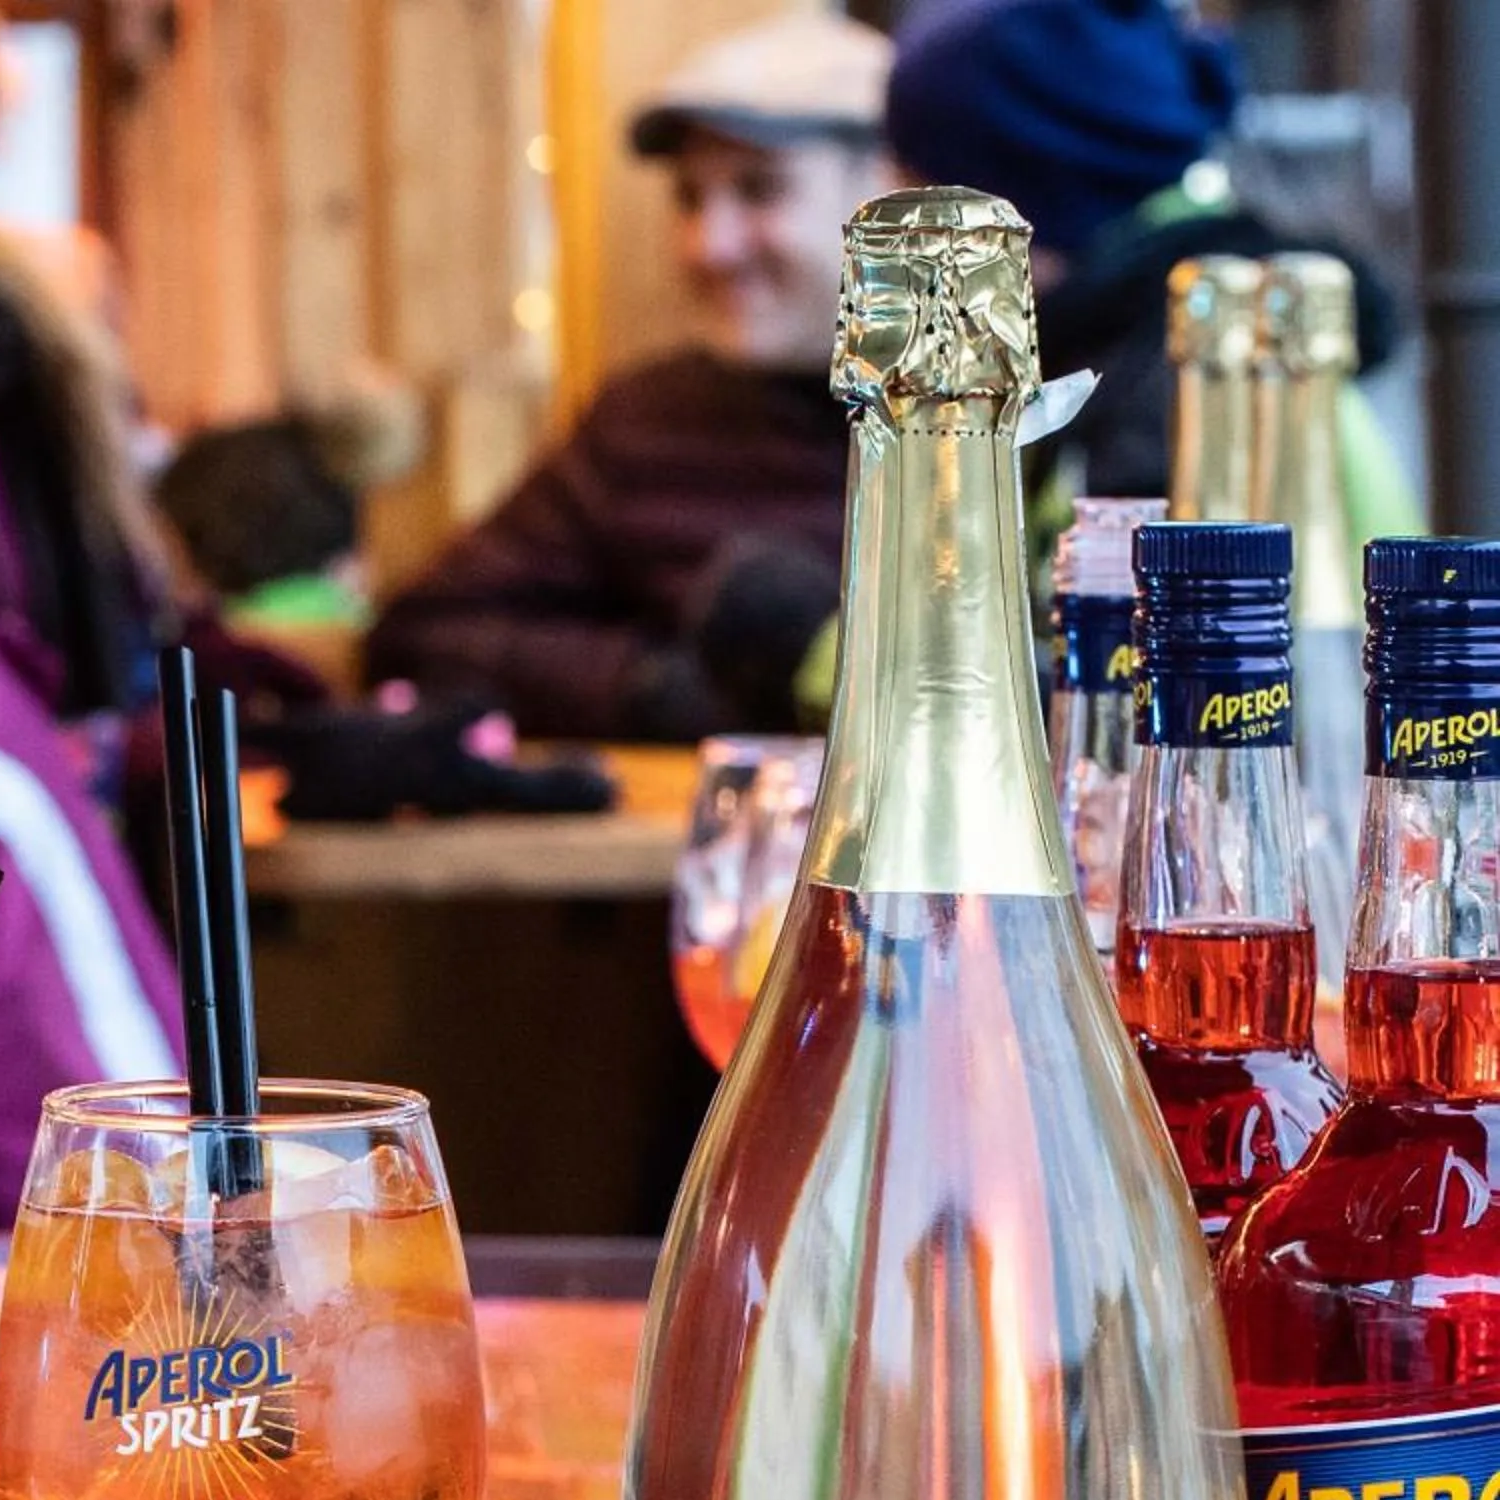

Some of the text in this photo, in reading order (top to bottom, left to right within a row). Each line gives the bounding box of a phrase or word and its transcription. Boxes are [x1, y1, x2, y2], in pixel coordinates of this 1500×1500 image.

[1392, 708, 1500, 759] APEROL
[1429, 749, 1467, 769] 1919
[84, 1336, 298, 1421] APEROL
